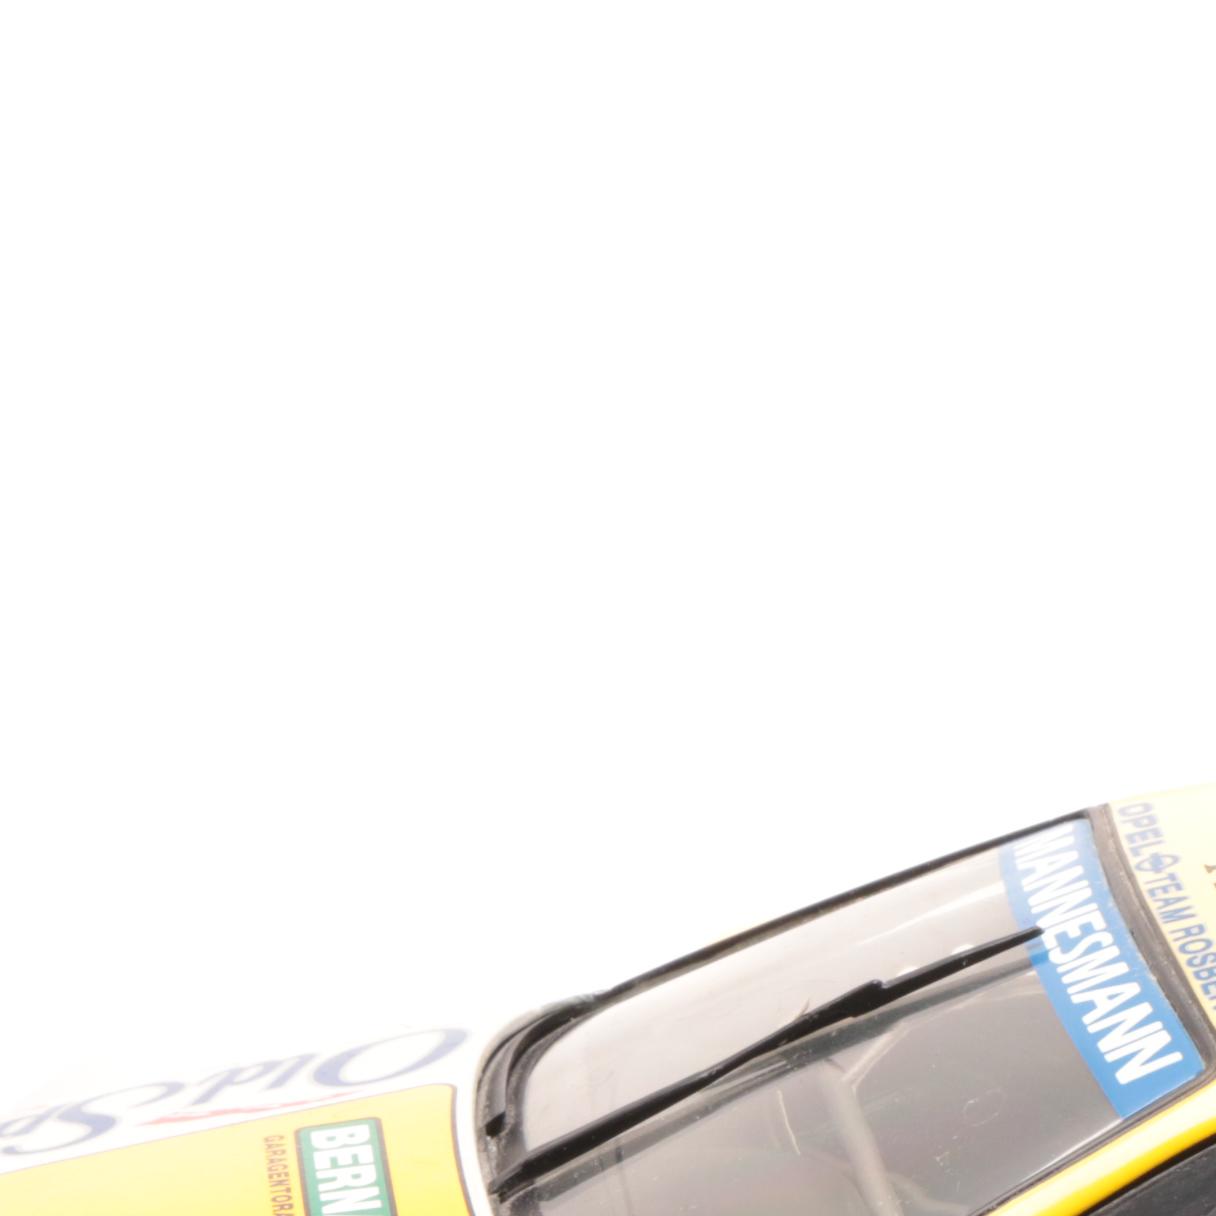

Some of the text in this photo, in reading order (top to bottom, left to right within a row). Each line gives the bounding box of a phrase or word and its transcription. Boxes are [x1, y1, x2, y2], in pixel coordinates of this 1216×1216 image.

[1015, 822, 1182, 1086] MANNESMANN
[1118, 803, 1167, 858] OPEL
[1146, 872, 1185, 925] TEAM
